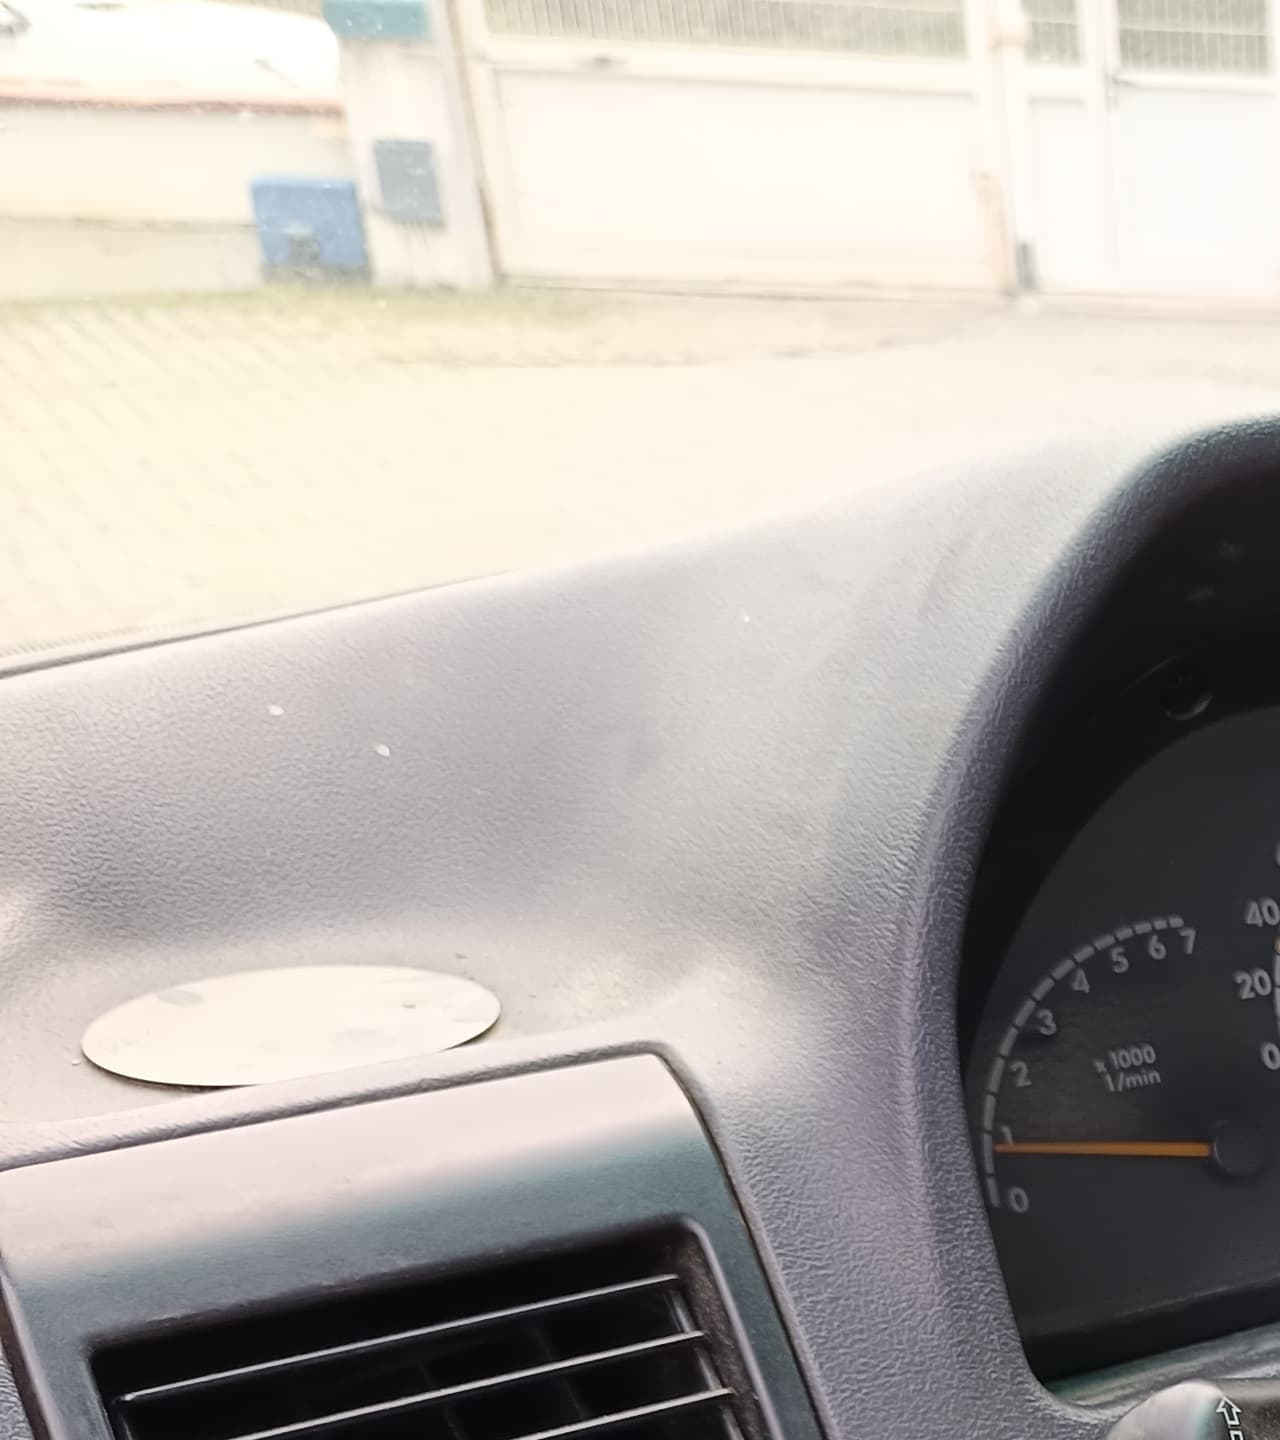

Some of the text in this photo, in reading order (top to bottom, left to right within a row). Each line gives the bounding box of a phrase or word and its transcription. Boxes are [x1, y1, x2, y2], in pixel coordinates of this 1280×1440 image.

[1245, 898, 1280, 927] 40
[1148, 934, 1167, 960] 6
[1180, 928, 1197, 955] 7
[1110, 946, 1129, 974] 5
[1071, 968, 1091, 994] 4
[1235, 968, 1271, 1000] 20
[1036, 1008, 1056, 1036] 3
[1109, 1044, 1157, 1070] 1000
[1010, 1060, 1032, 1088] 2
[1103, 1067, 1161, 1093] 1/min
[1008, 1187, 1030, 1214] 0
